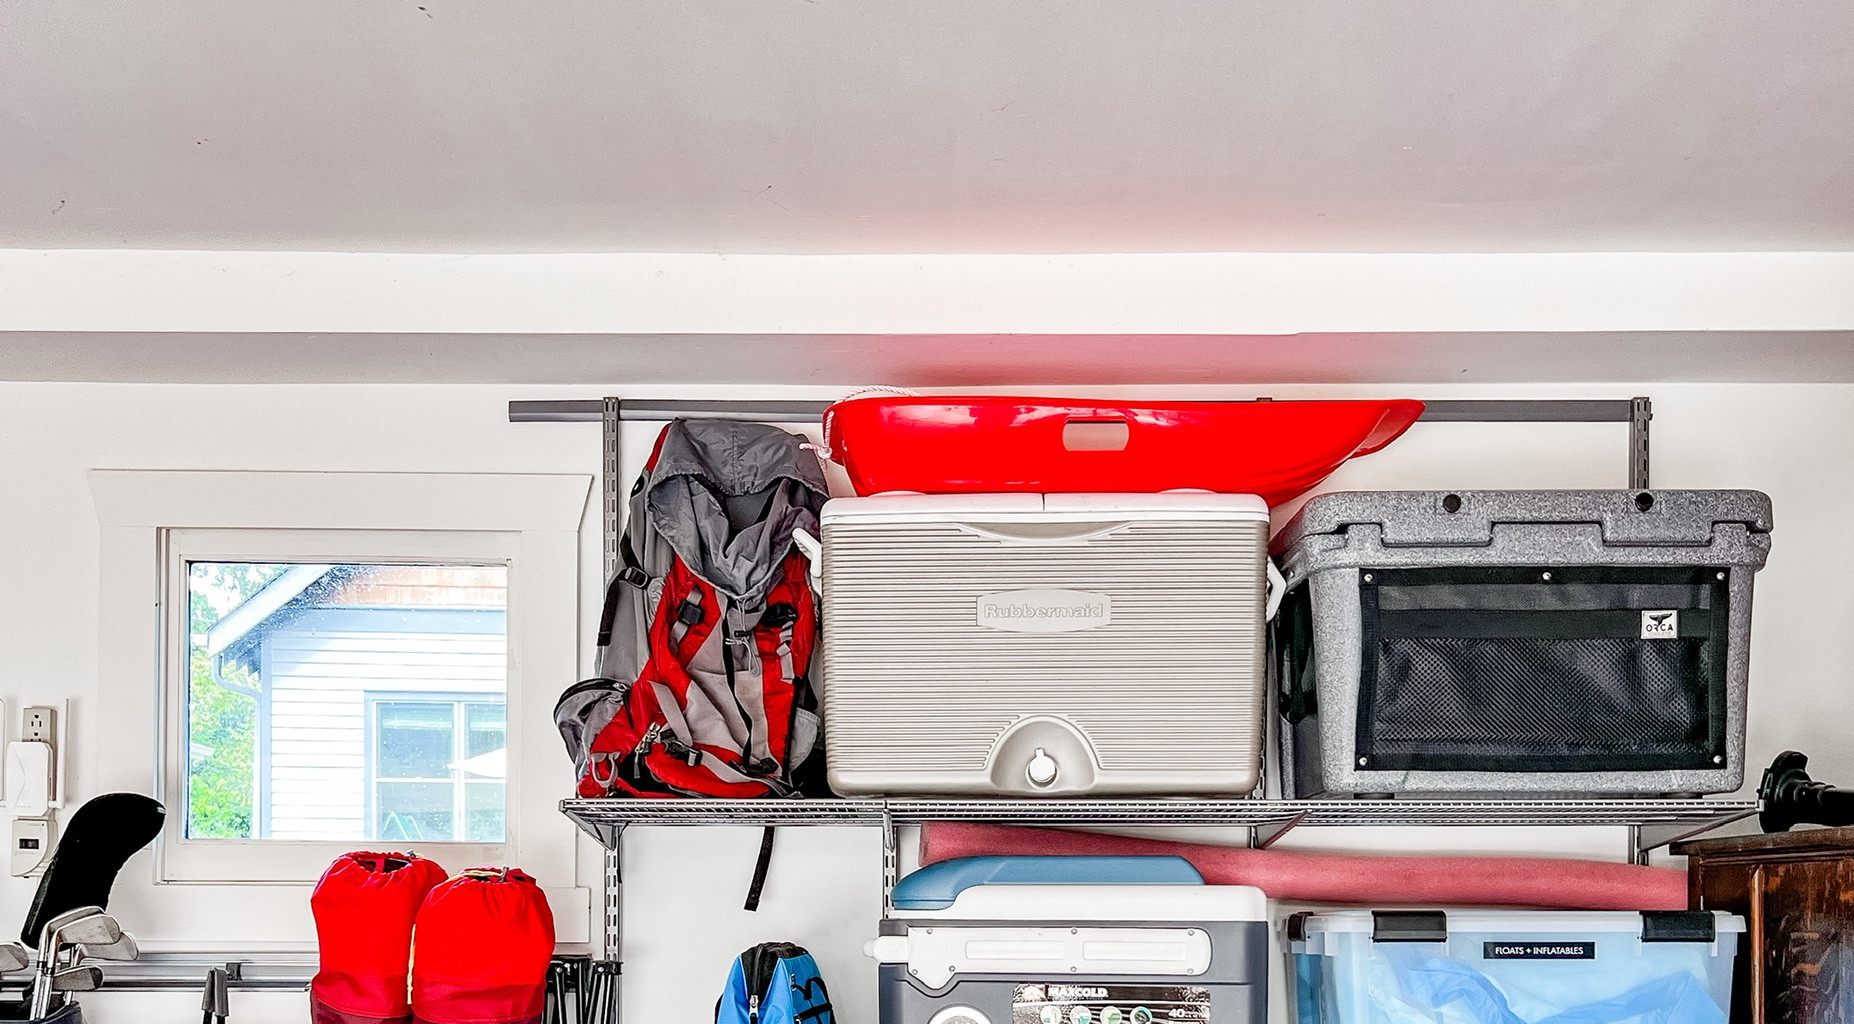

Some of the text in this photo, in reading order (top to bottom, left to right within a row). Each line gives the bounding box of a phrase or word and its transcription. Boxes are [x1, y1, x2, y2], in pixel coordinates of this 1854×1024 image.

[983, 603, 1104, 619] Rubbermaid
[1645, 623, 1674, 632] ORCA
[1495, 946, 1525, 955] FLOATS
[1533, 946, 1584, 955] INFLATABLES
[1047, 987, 1109, 998] MAXCOLD
